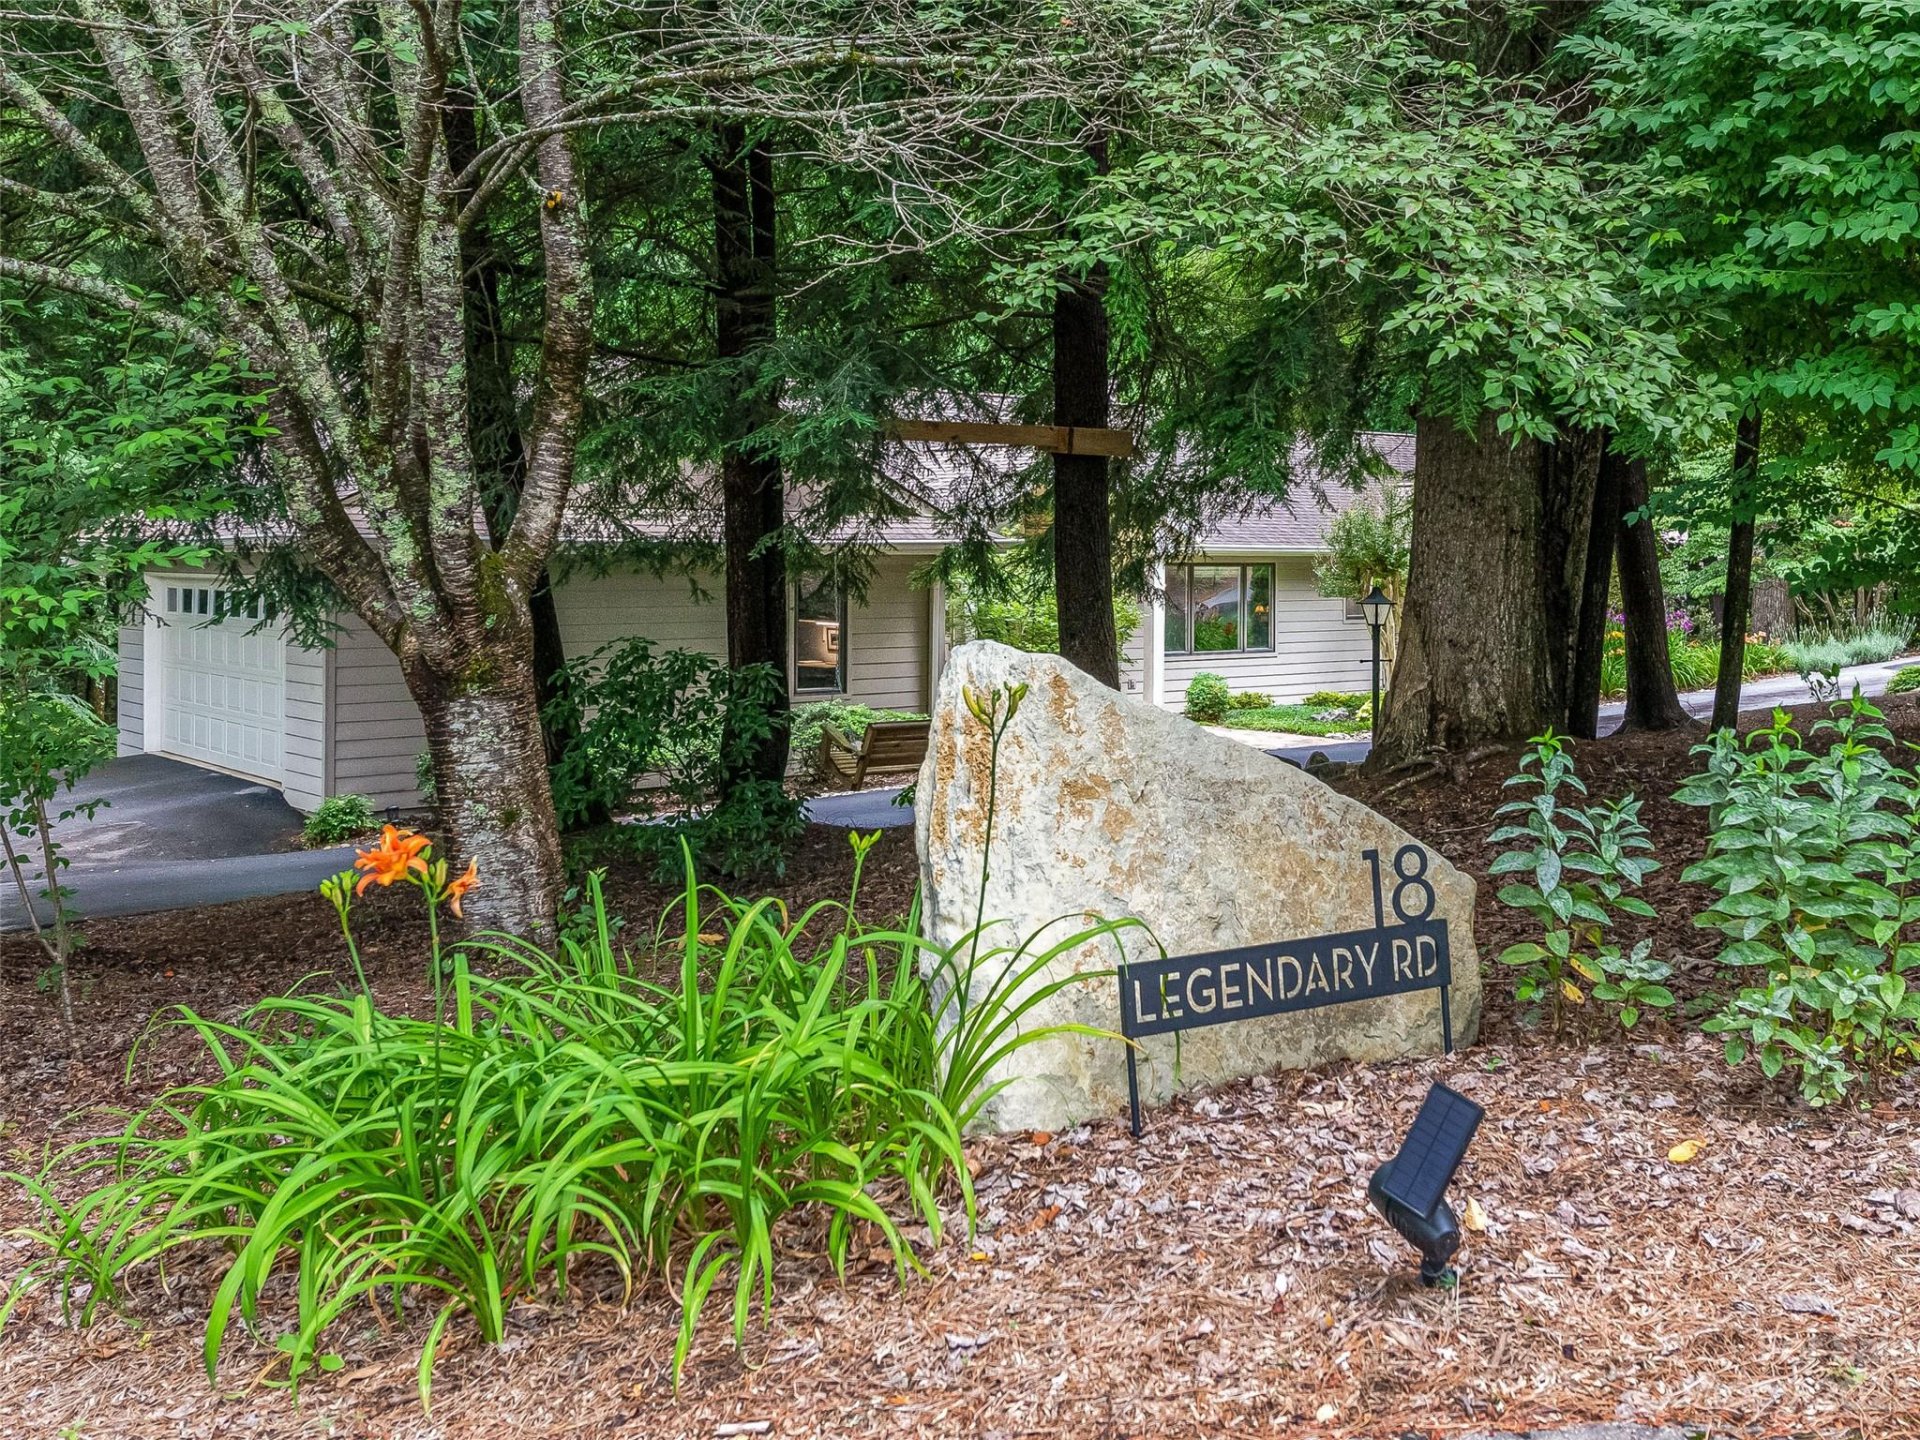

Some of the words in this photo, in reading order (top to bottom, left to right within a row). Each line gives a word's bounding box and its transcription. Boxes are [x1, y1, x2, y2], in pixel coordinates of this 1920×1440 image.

[1362, 845, 1435, 925] 18
[1134, 942, 1379, 1024] LEGENDARY
[1392, 935, 1438, 983] RD
